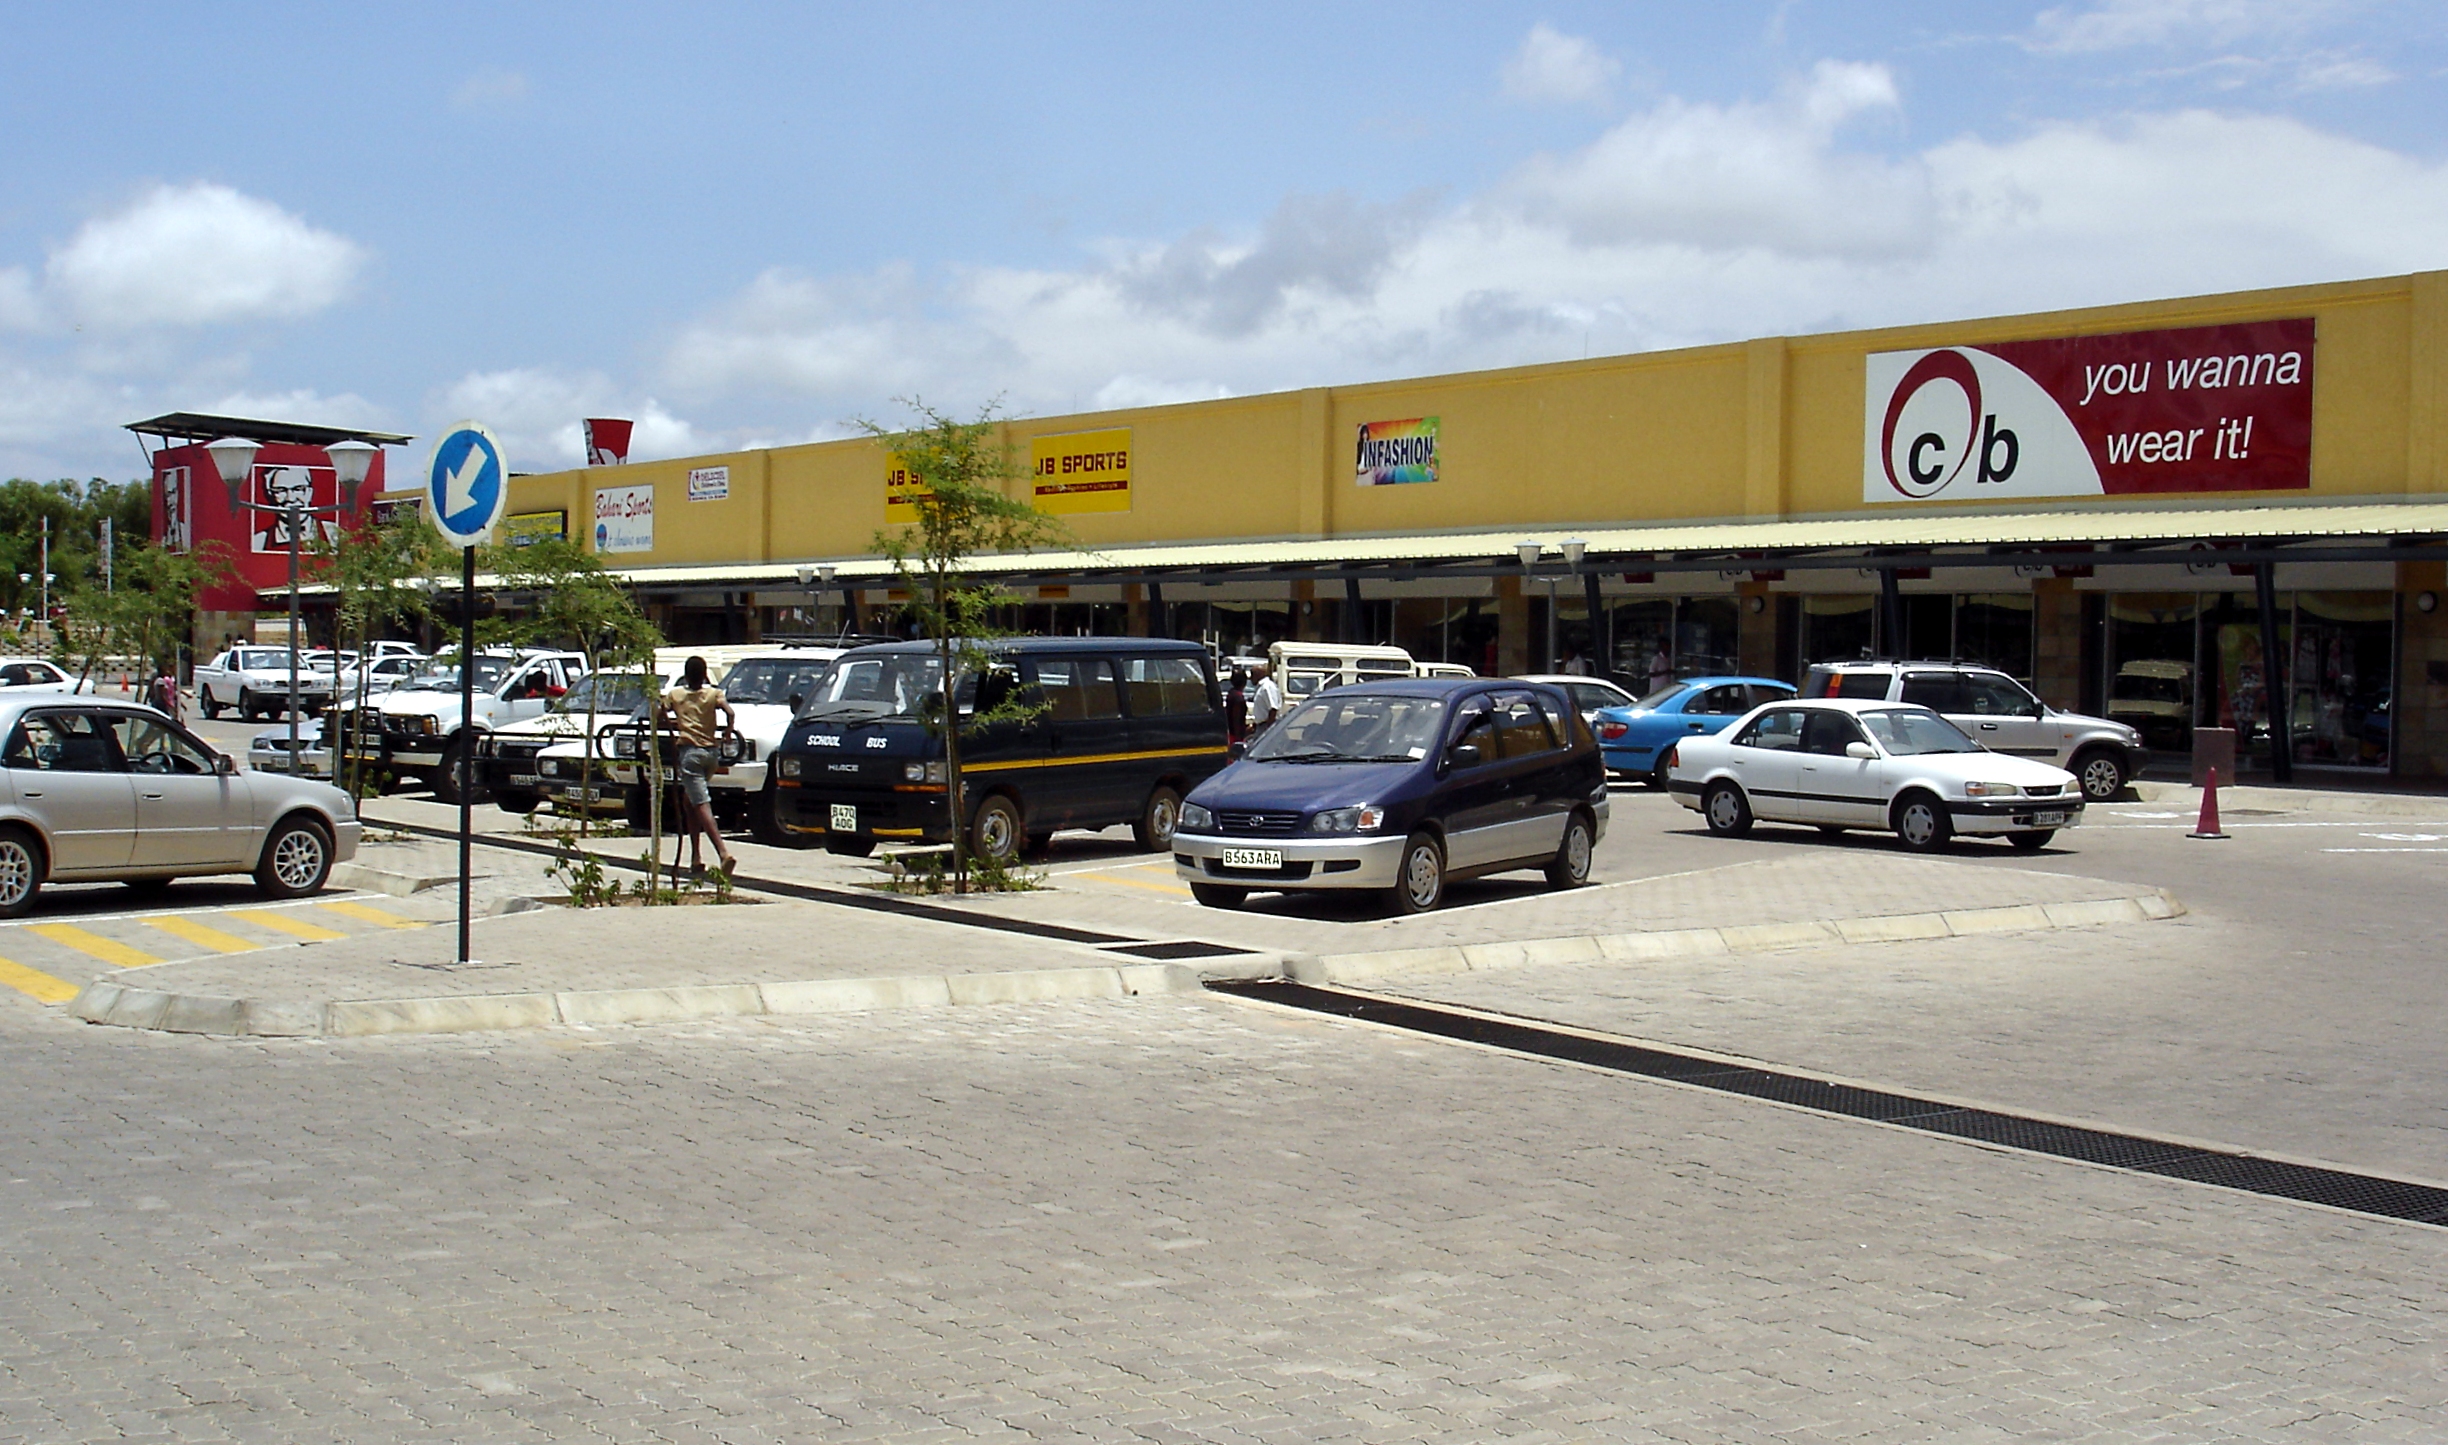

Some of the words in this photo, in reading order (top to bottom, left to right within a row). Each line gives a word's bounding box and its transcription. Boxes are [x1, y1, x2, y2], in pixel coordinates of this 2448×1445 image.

[2079, 360, 2151, 405] you
[2166, 351, 2302, 390] wanna
[1363, 435, 1434, 469] INFASHION
[2106, 428, 2204, 465] wear
[2213, 416, 2254, 461] it!
[1035, 457, 1055, 476] JB
[1062, 451, 1127, 474] SPORTS
[888, 469, 905, 487] JB
[807, 735, 840, 747] SCHOOL
[866, 737, 888, 749] BUS
[1225, 851, 1280, 866] B563ARA
